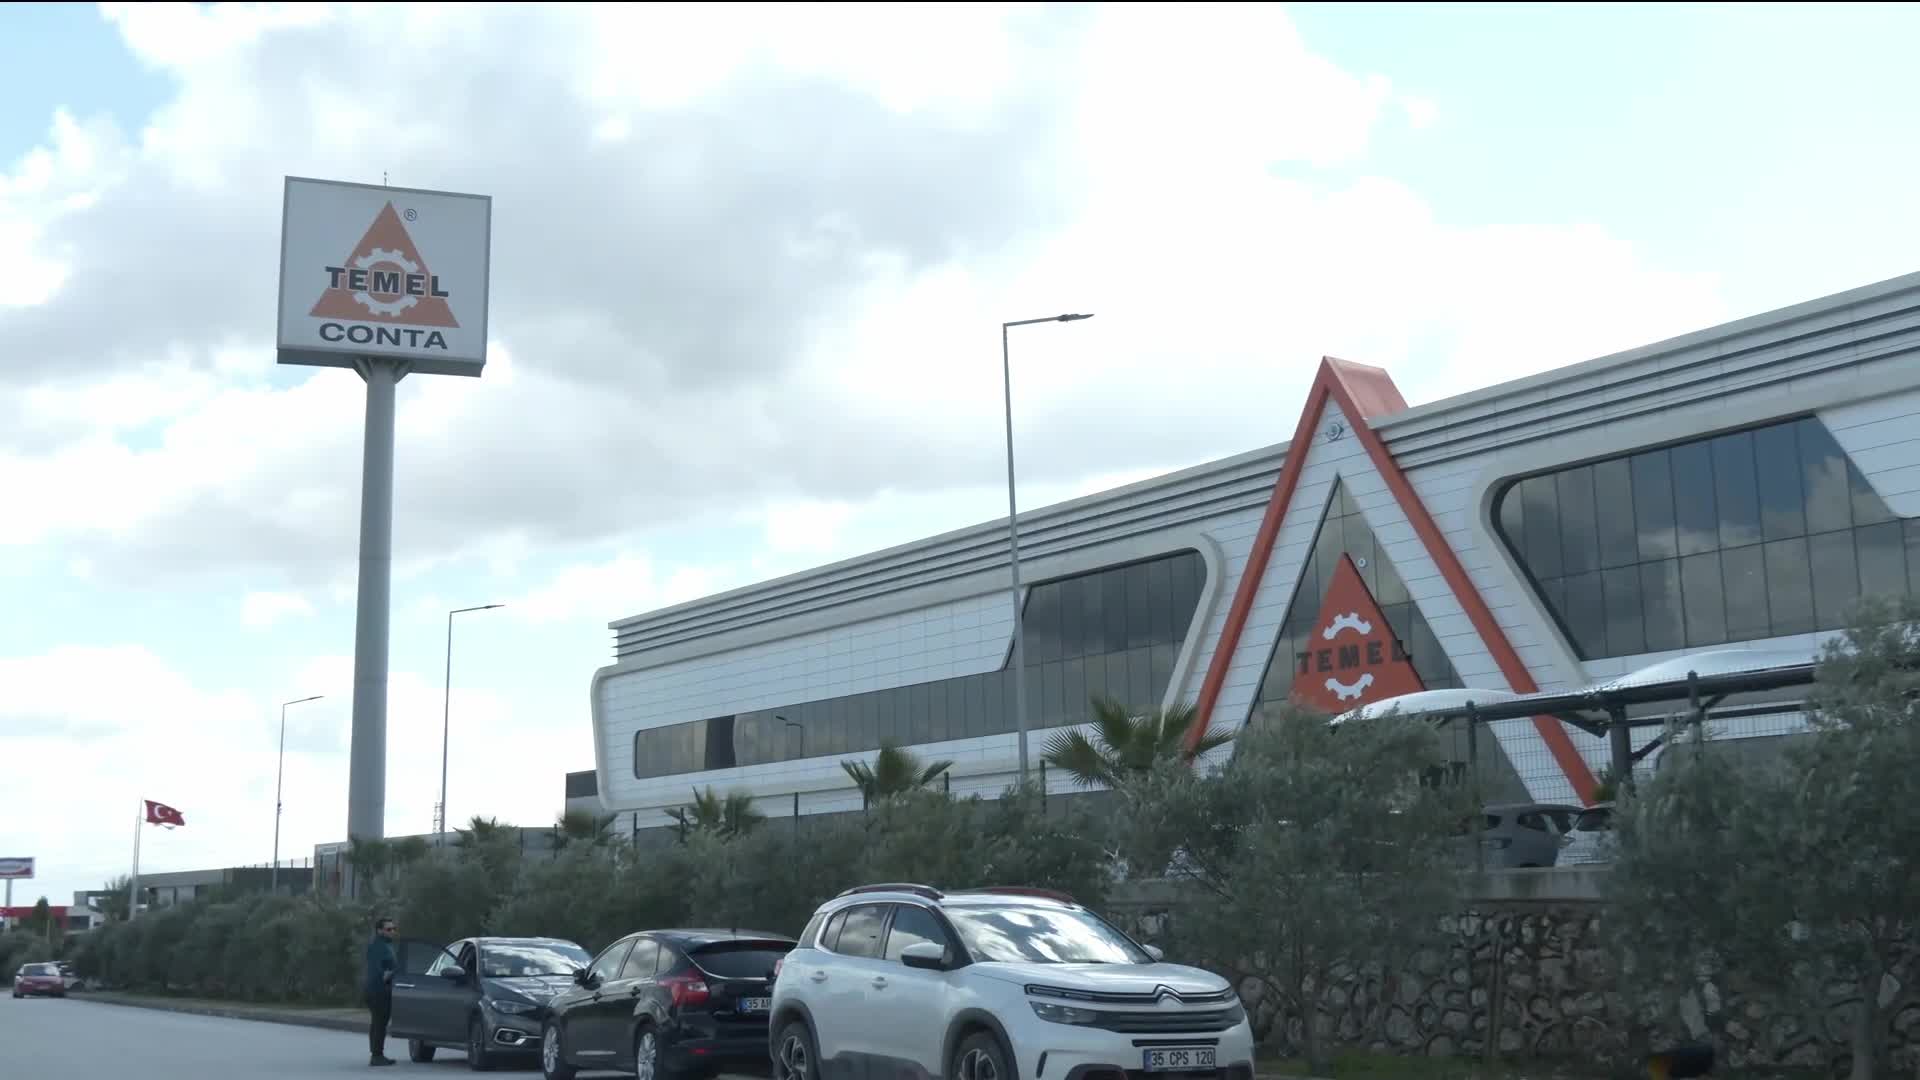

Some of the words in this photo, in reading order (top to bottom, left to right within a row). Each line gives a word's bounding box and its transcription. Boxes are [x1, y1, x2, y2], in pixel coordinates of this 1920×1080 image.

[325, 266, 449, 297] TEMEL
[319, 323, 448, 349] CONTA
[1296, 639, 1412, 674] TEMEL
[1152, 1052, 1164, 1066] 35
[1169, 1051, 1189, 1066] CPS
[1196, 1050, 1213, 1065] 120
